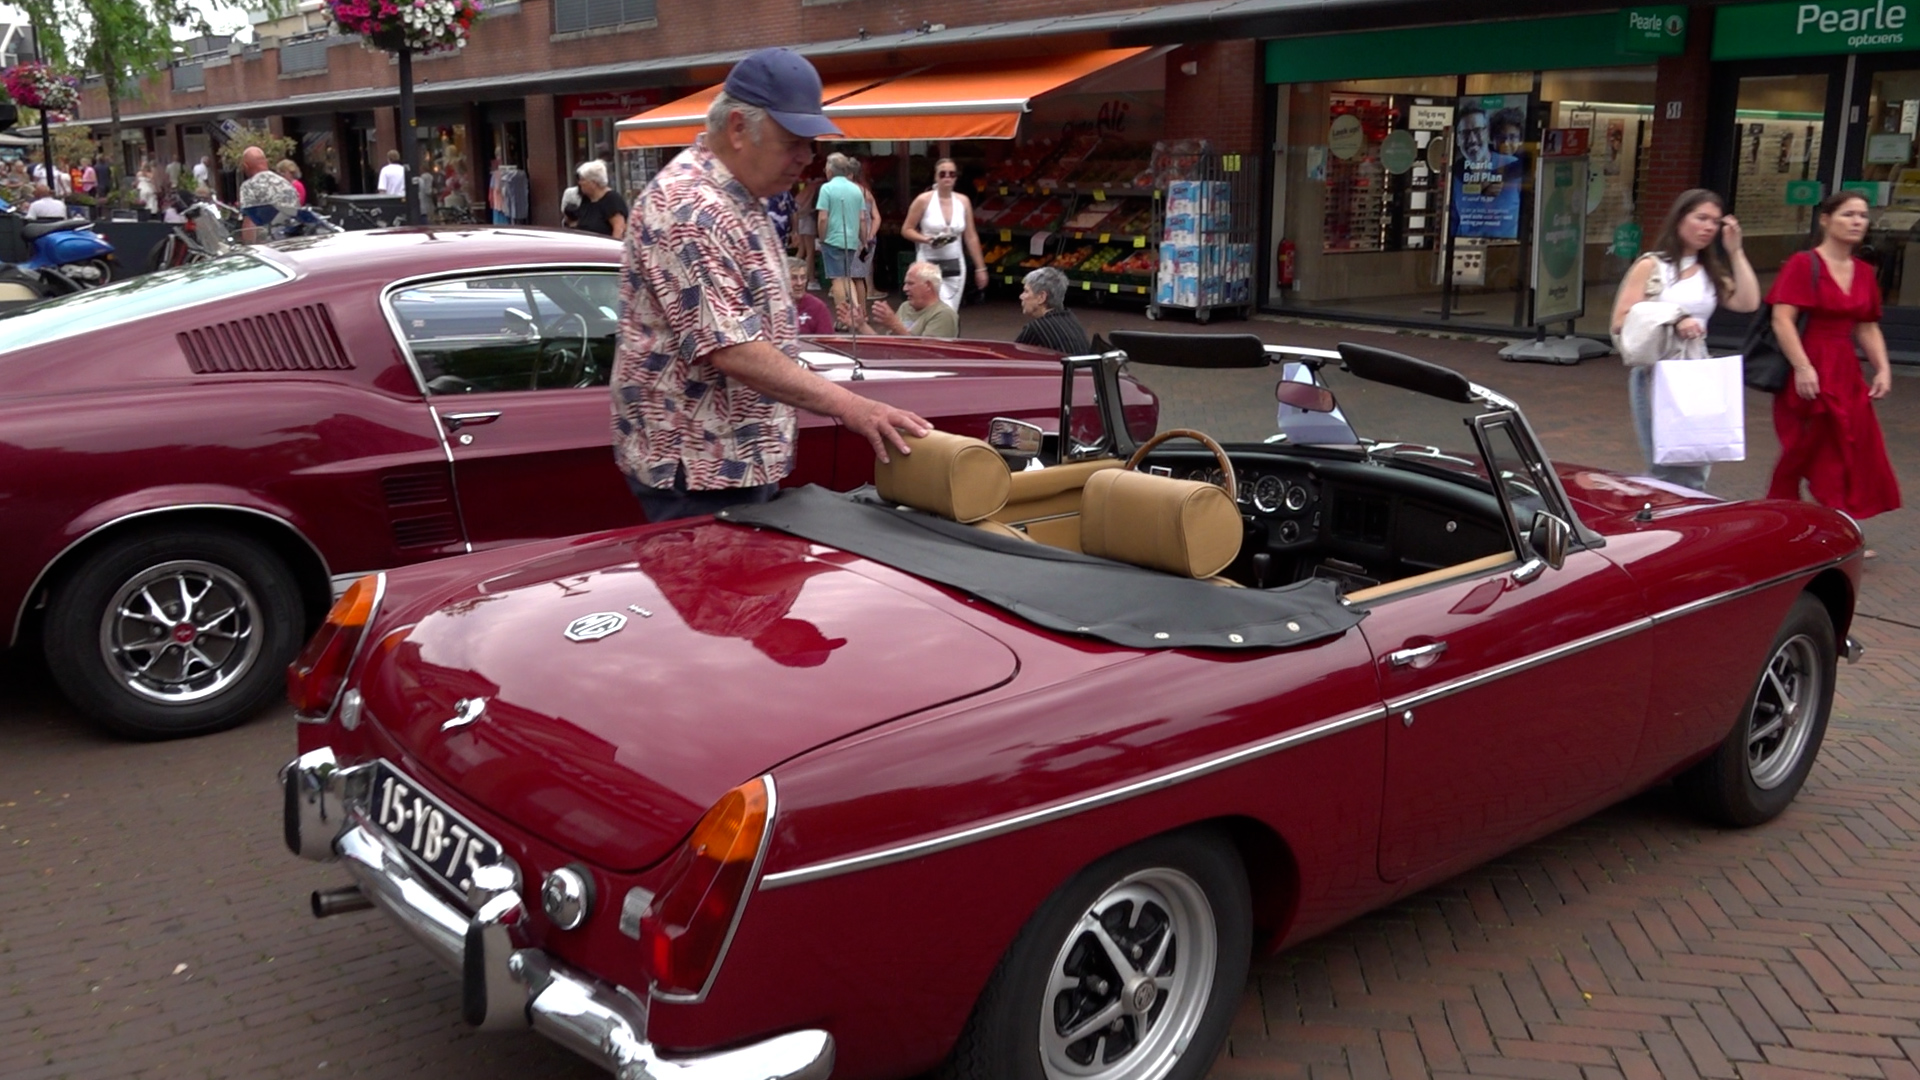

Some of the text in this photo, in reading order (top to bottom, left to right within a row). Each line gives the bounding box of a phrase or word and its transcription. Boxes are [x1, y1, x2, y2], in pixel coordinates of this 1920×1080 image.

[1629, 12, 1662, 31] Pearle
[1797, 0, 1906, 34] Pearle
[1848, 33, 1903, 47] opticiens
[1464, 160, 1493, 170] Pearle
[1463, 172, 1503, 183] Bril Plan
[568, 613, 623, 638] MG
[379, 776, 485, 891] 15-YB-75
